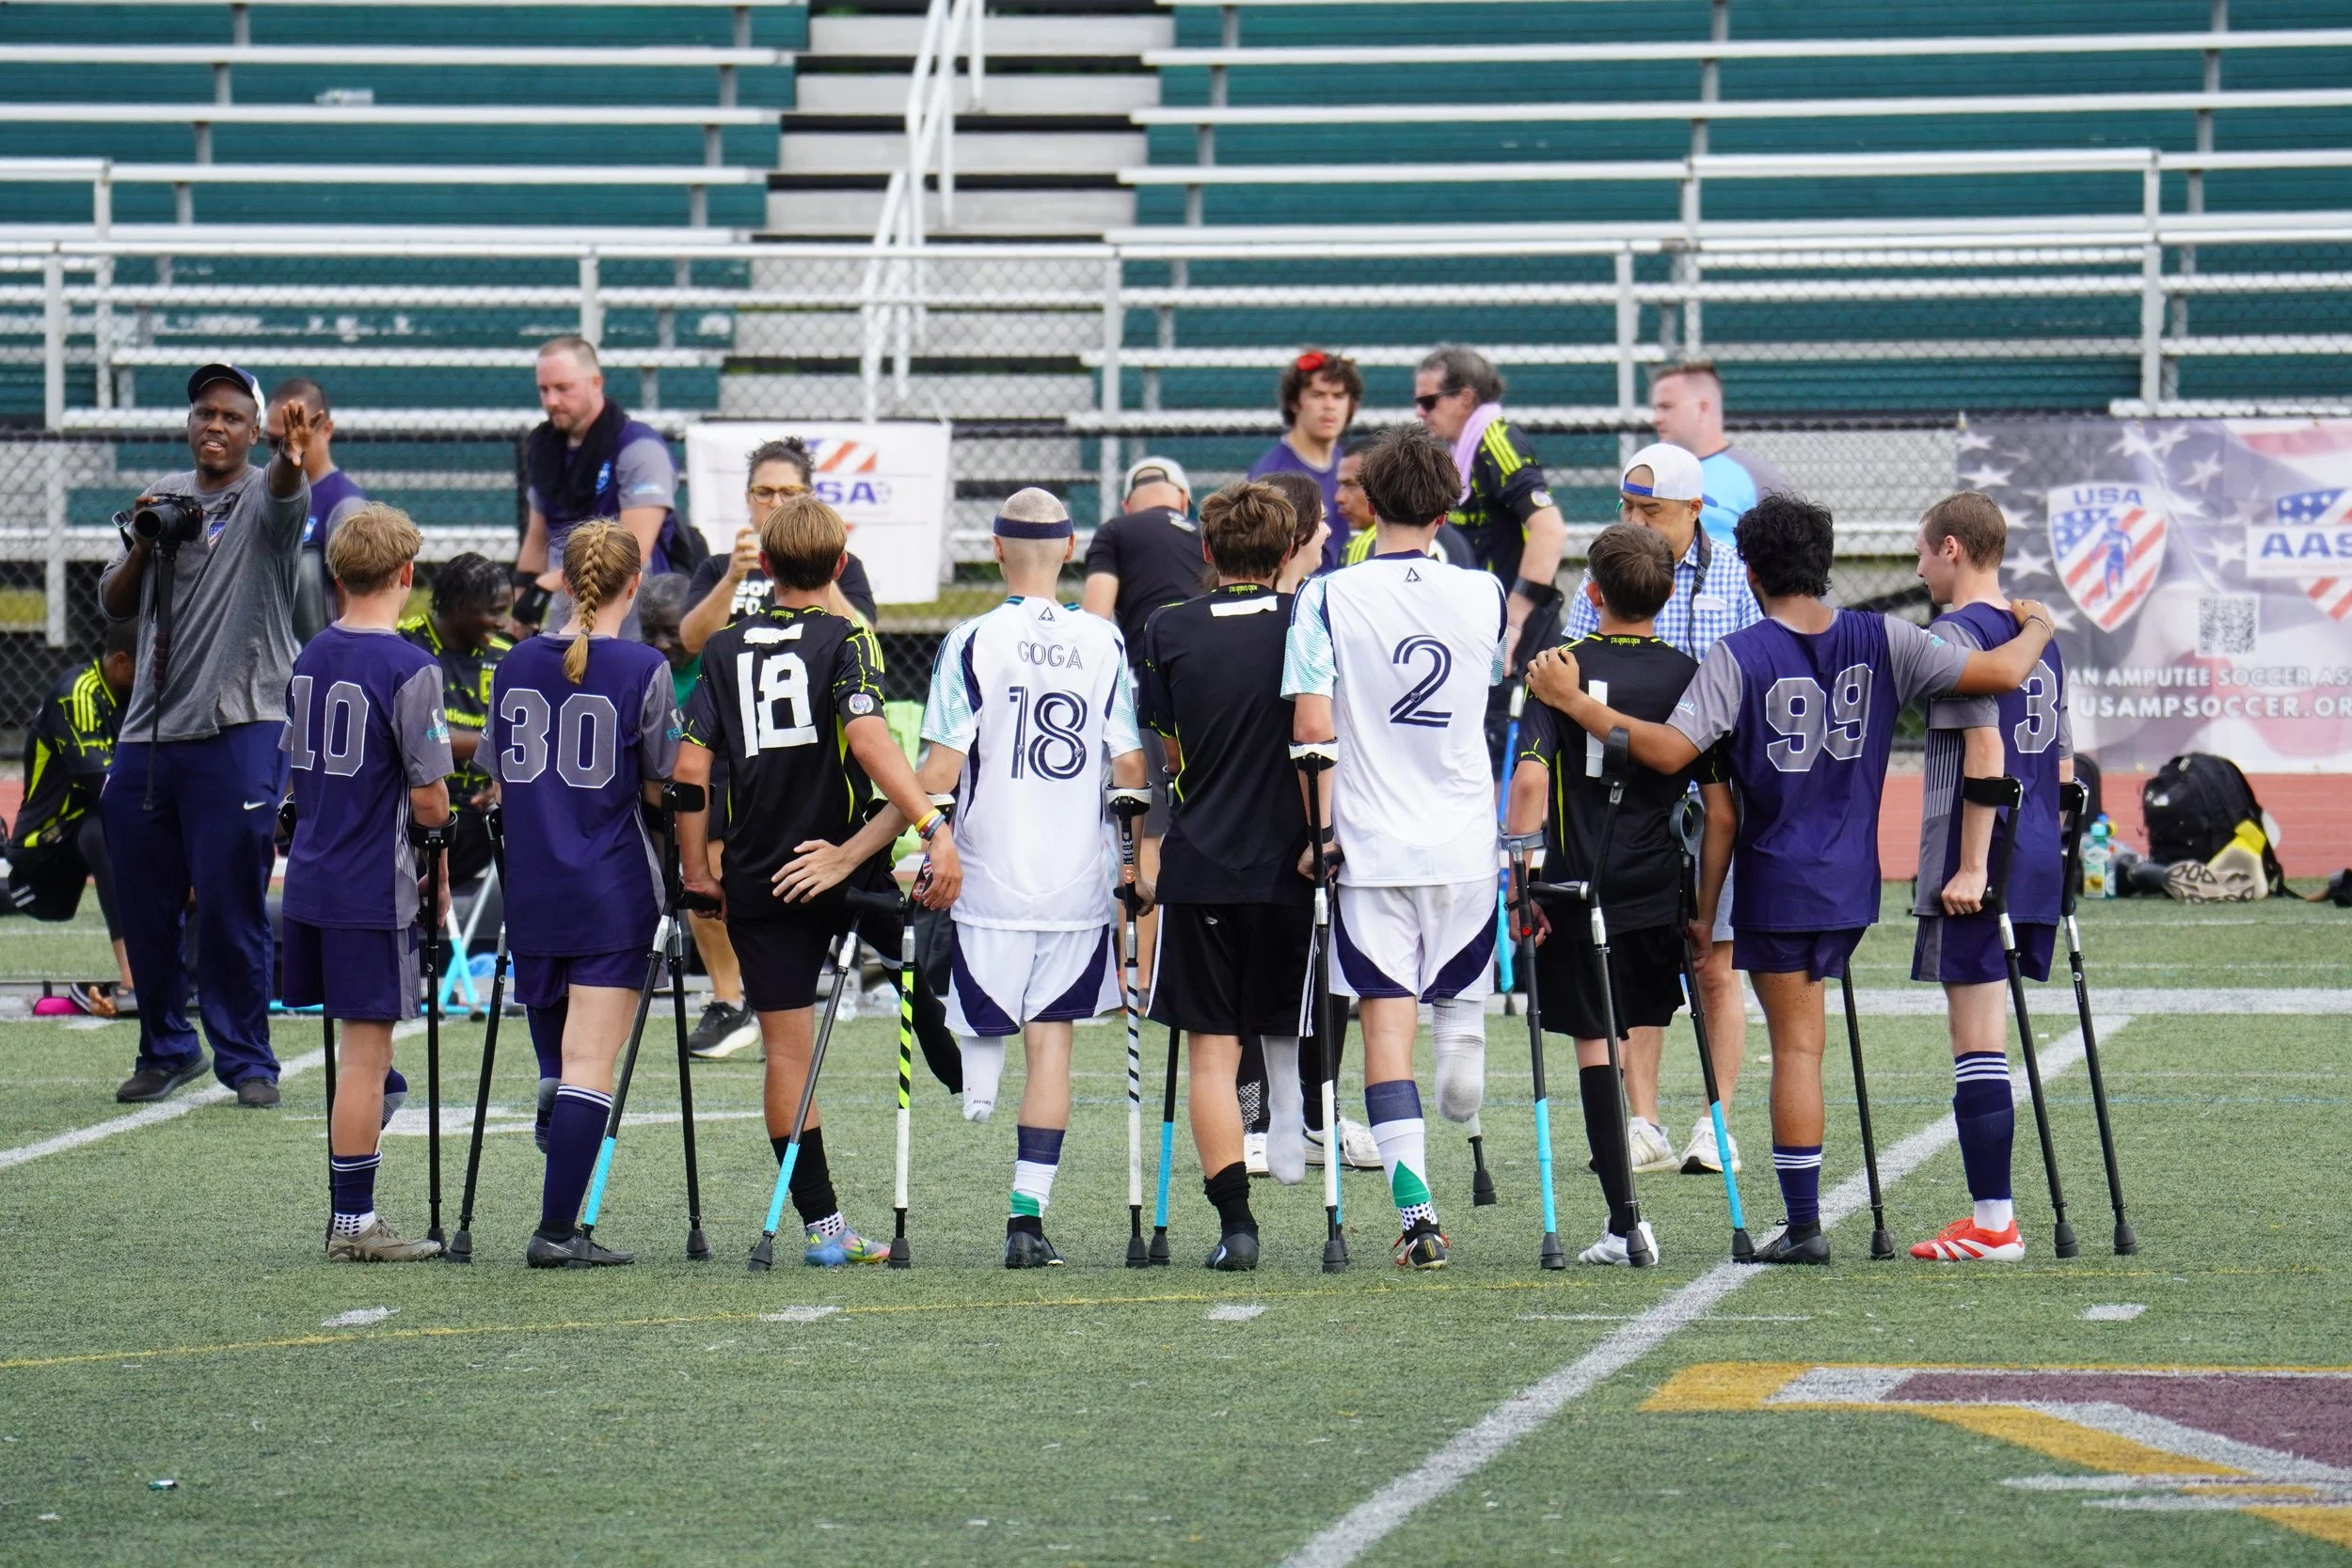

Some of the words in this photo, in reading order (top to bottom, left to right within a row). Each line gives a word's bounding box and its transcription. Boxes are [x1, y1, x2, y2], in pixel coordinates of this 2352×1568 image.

[2073, 487, 2142, 506] USA
[1017, 641, 1083, 670] GOGA
[1390, 634, 1453, 728] 2
[2105, 667, 2211, 687] AMPUTEE
[2217, 668, 2313, 687] SOCCER
[291, 675, 370, 777] 10
[501, 689, 617, 788] 30
[737, 651, 818, 758] 18
[1009, 686, 1088, 782] 18
[1765, 663, 1874, 771] 99
[2014, 659, 2058, 752] 3
